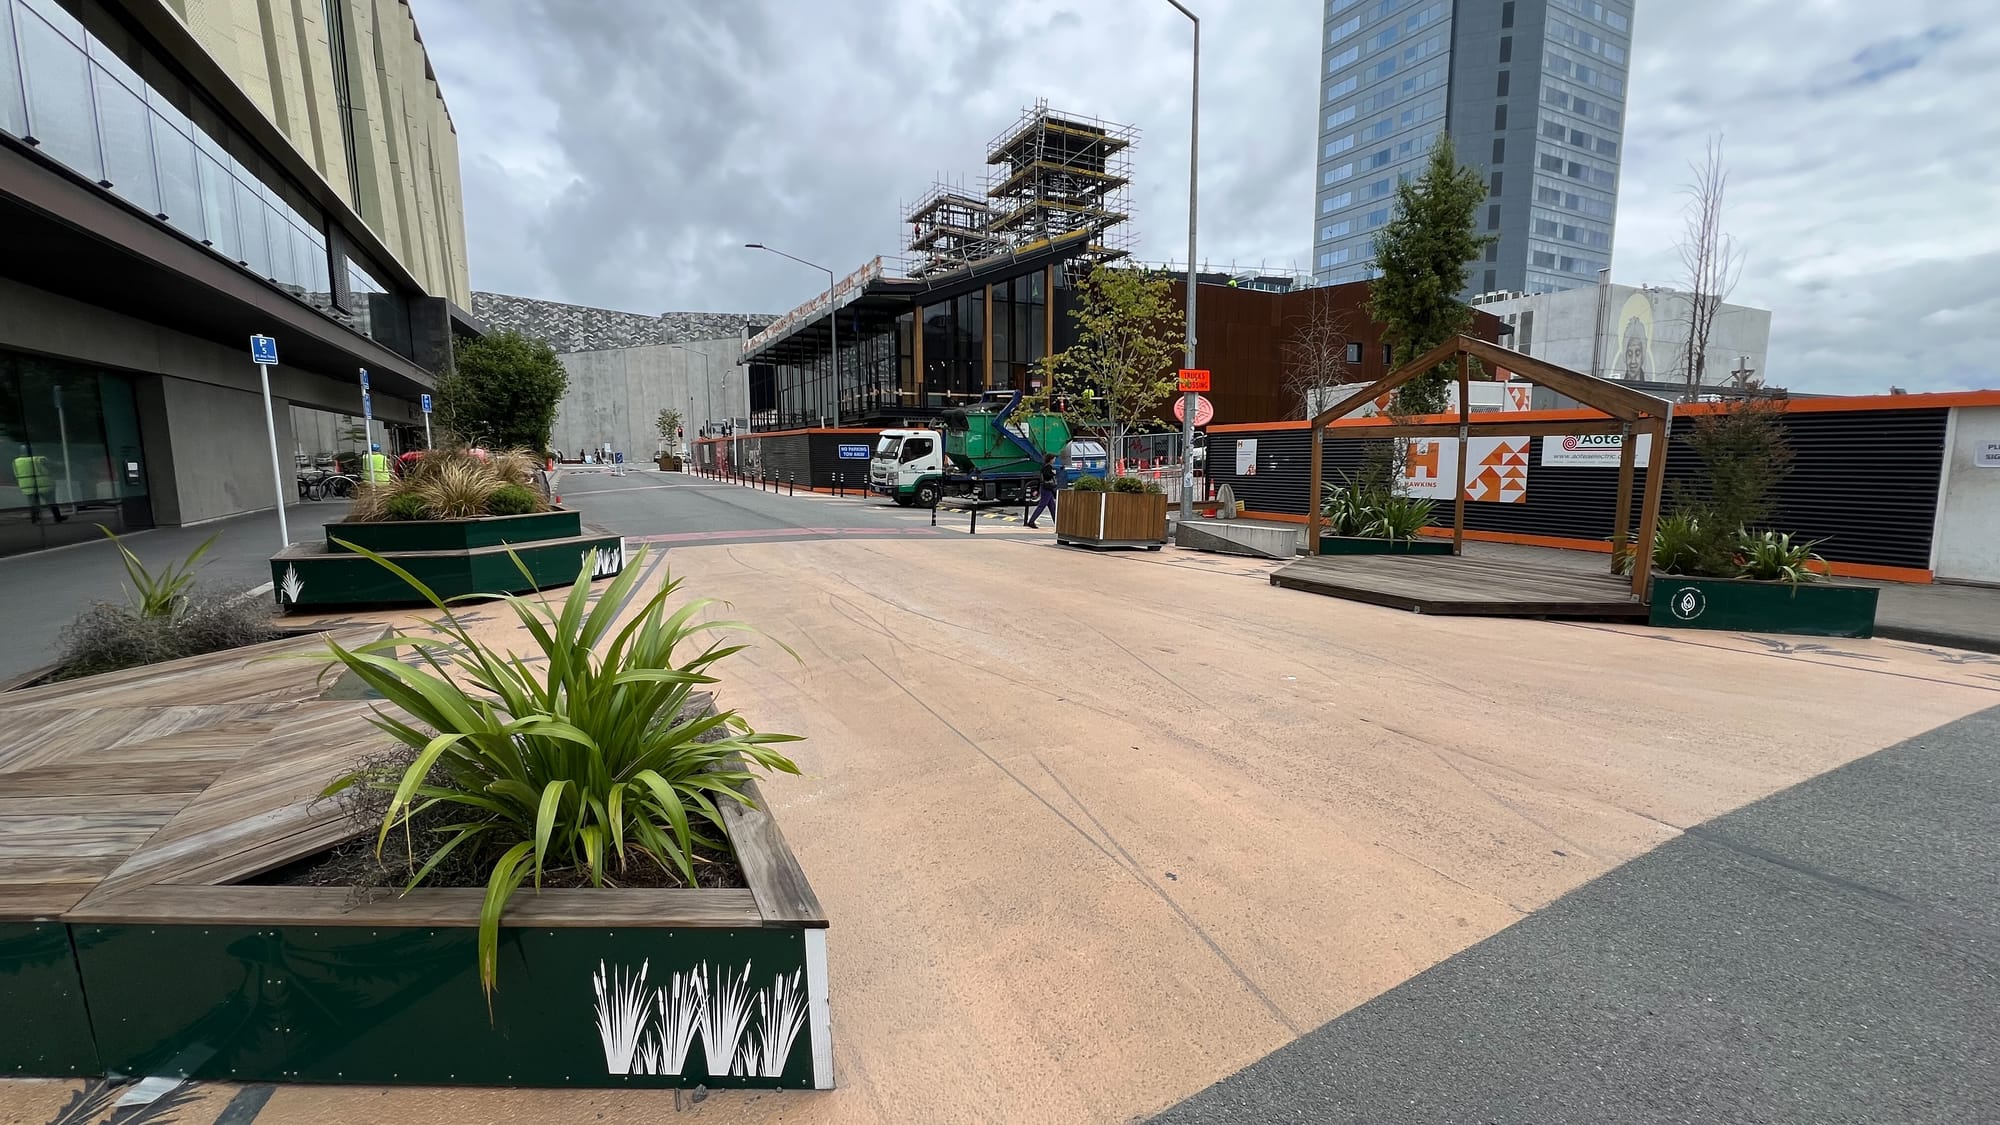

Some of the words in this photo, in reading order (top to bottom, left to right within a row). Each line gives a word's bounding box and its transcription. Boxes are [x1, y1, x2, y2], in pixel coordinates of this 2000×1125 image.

[259, 339, 267, 347] P
[1582, 435, 1623, 444] Aote
[1405, 443, 1440, 479] H
